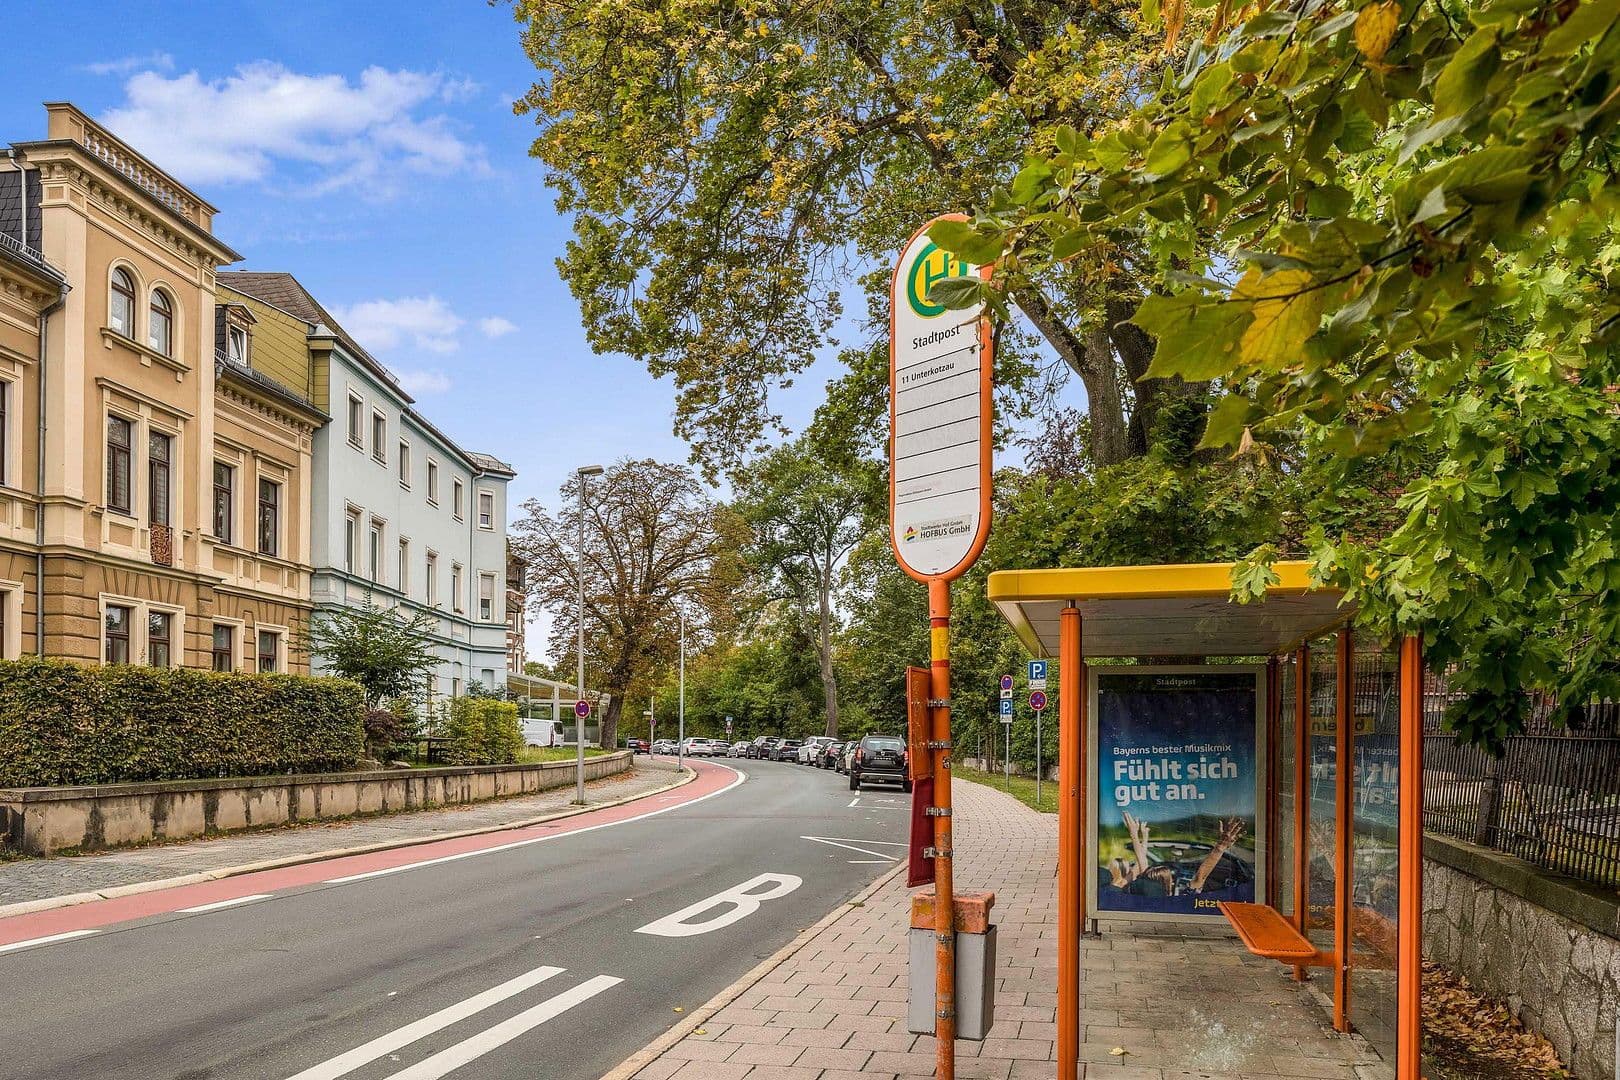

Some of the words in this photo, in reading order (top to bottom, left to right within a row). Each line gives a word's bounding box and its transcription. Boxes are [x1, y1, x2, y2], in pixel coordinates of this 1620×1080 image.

[912, 325, 961, 350] Stadtpost
[902, 375, 909, 384] 11
[911, 362, 955, 382] Unterkotzau
[920, 527, 948, 539] HOFBUS
[949, 525, 971, 535] GmbH
[1032, 663, 1042, 679] P
[1156, 678, 1196, 687] Stadtpost
[1113, 746, 1150, 757] Bayerns
[1152, 745, 1183, 754] bester
[1184, 743, 1232, 753] Musikmix
[1114, 758, 1182, 781] Fühlt
[1187, 755, 1238, 779] sich
[1114, 781, 1160, 807] gut
[1165, 783, 1206, 800] an.
[633, 872, 803, 937] B
